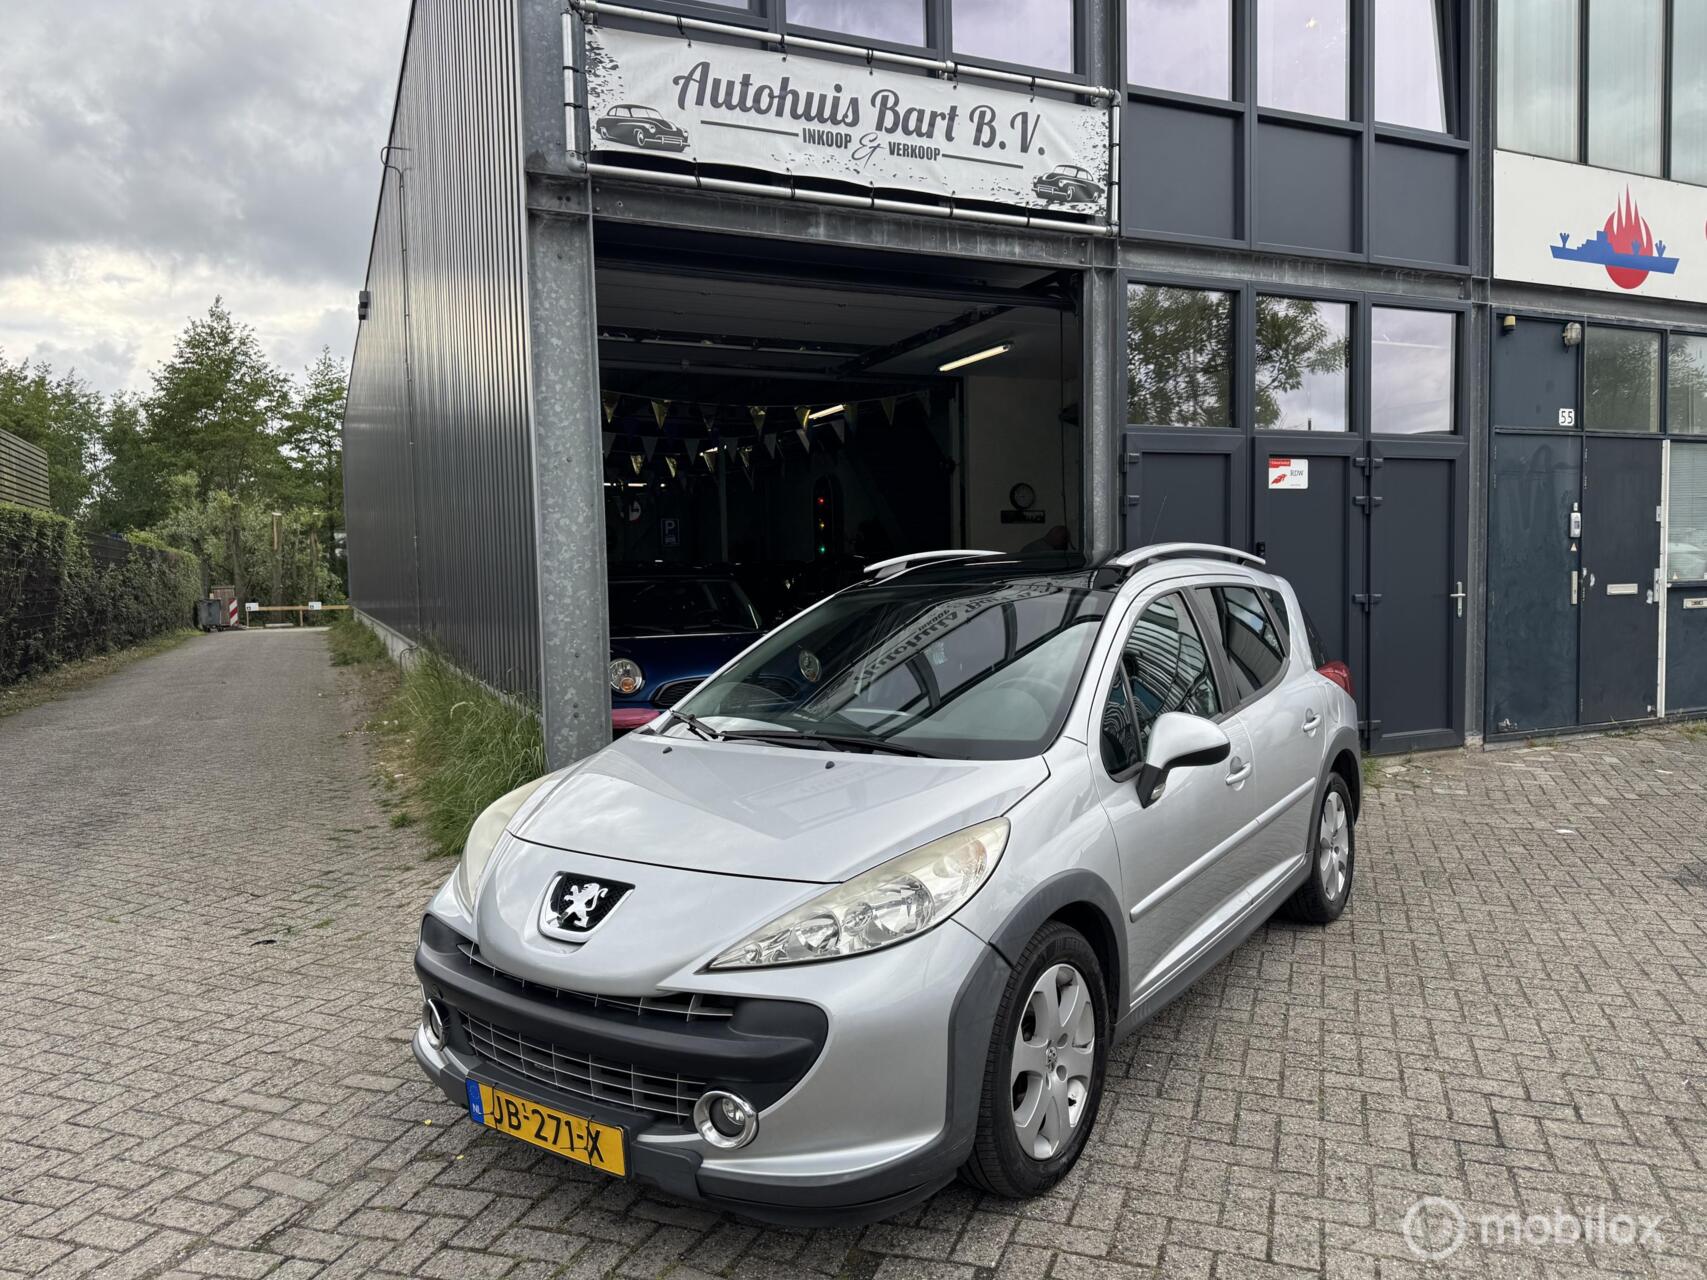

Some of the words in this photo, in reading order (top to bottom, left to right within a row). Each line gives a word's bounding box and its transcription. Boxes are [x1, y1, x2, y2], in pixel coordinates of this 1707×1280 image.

[673, 61, 861, 127] Autohuis
[870, 88, 959, 142] Bart
[969, 104, 1046, 156] B.V.
[802, 127, 852, 150] INKOOP
[888, 141, 941, 162] VERKOOP
[1560, 410, 1573, 424] 55
[664, 520, 675, 535] P
[472, 1103, 482, 1115] NL
[494, 1095, 604, 1163] JB-271-X
